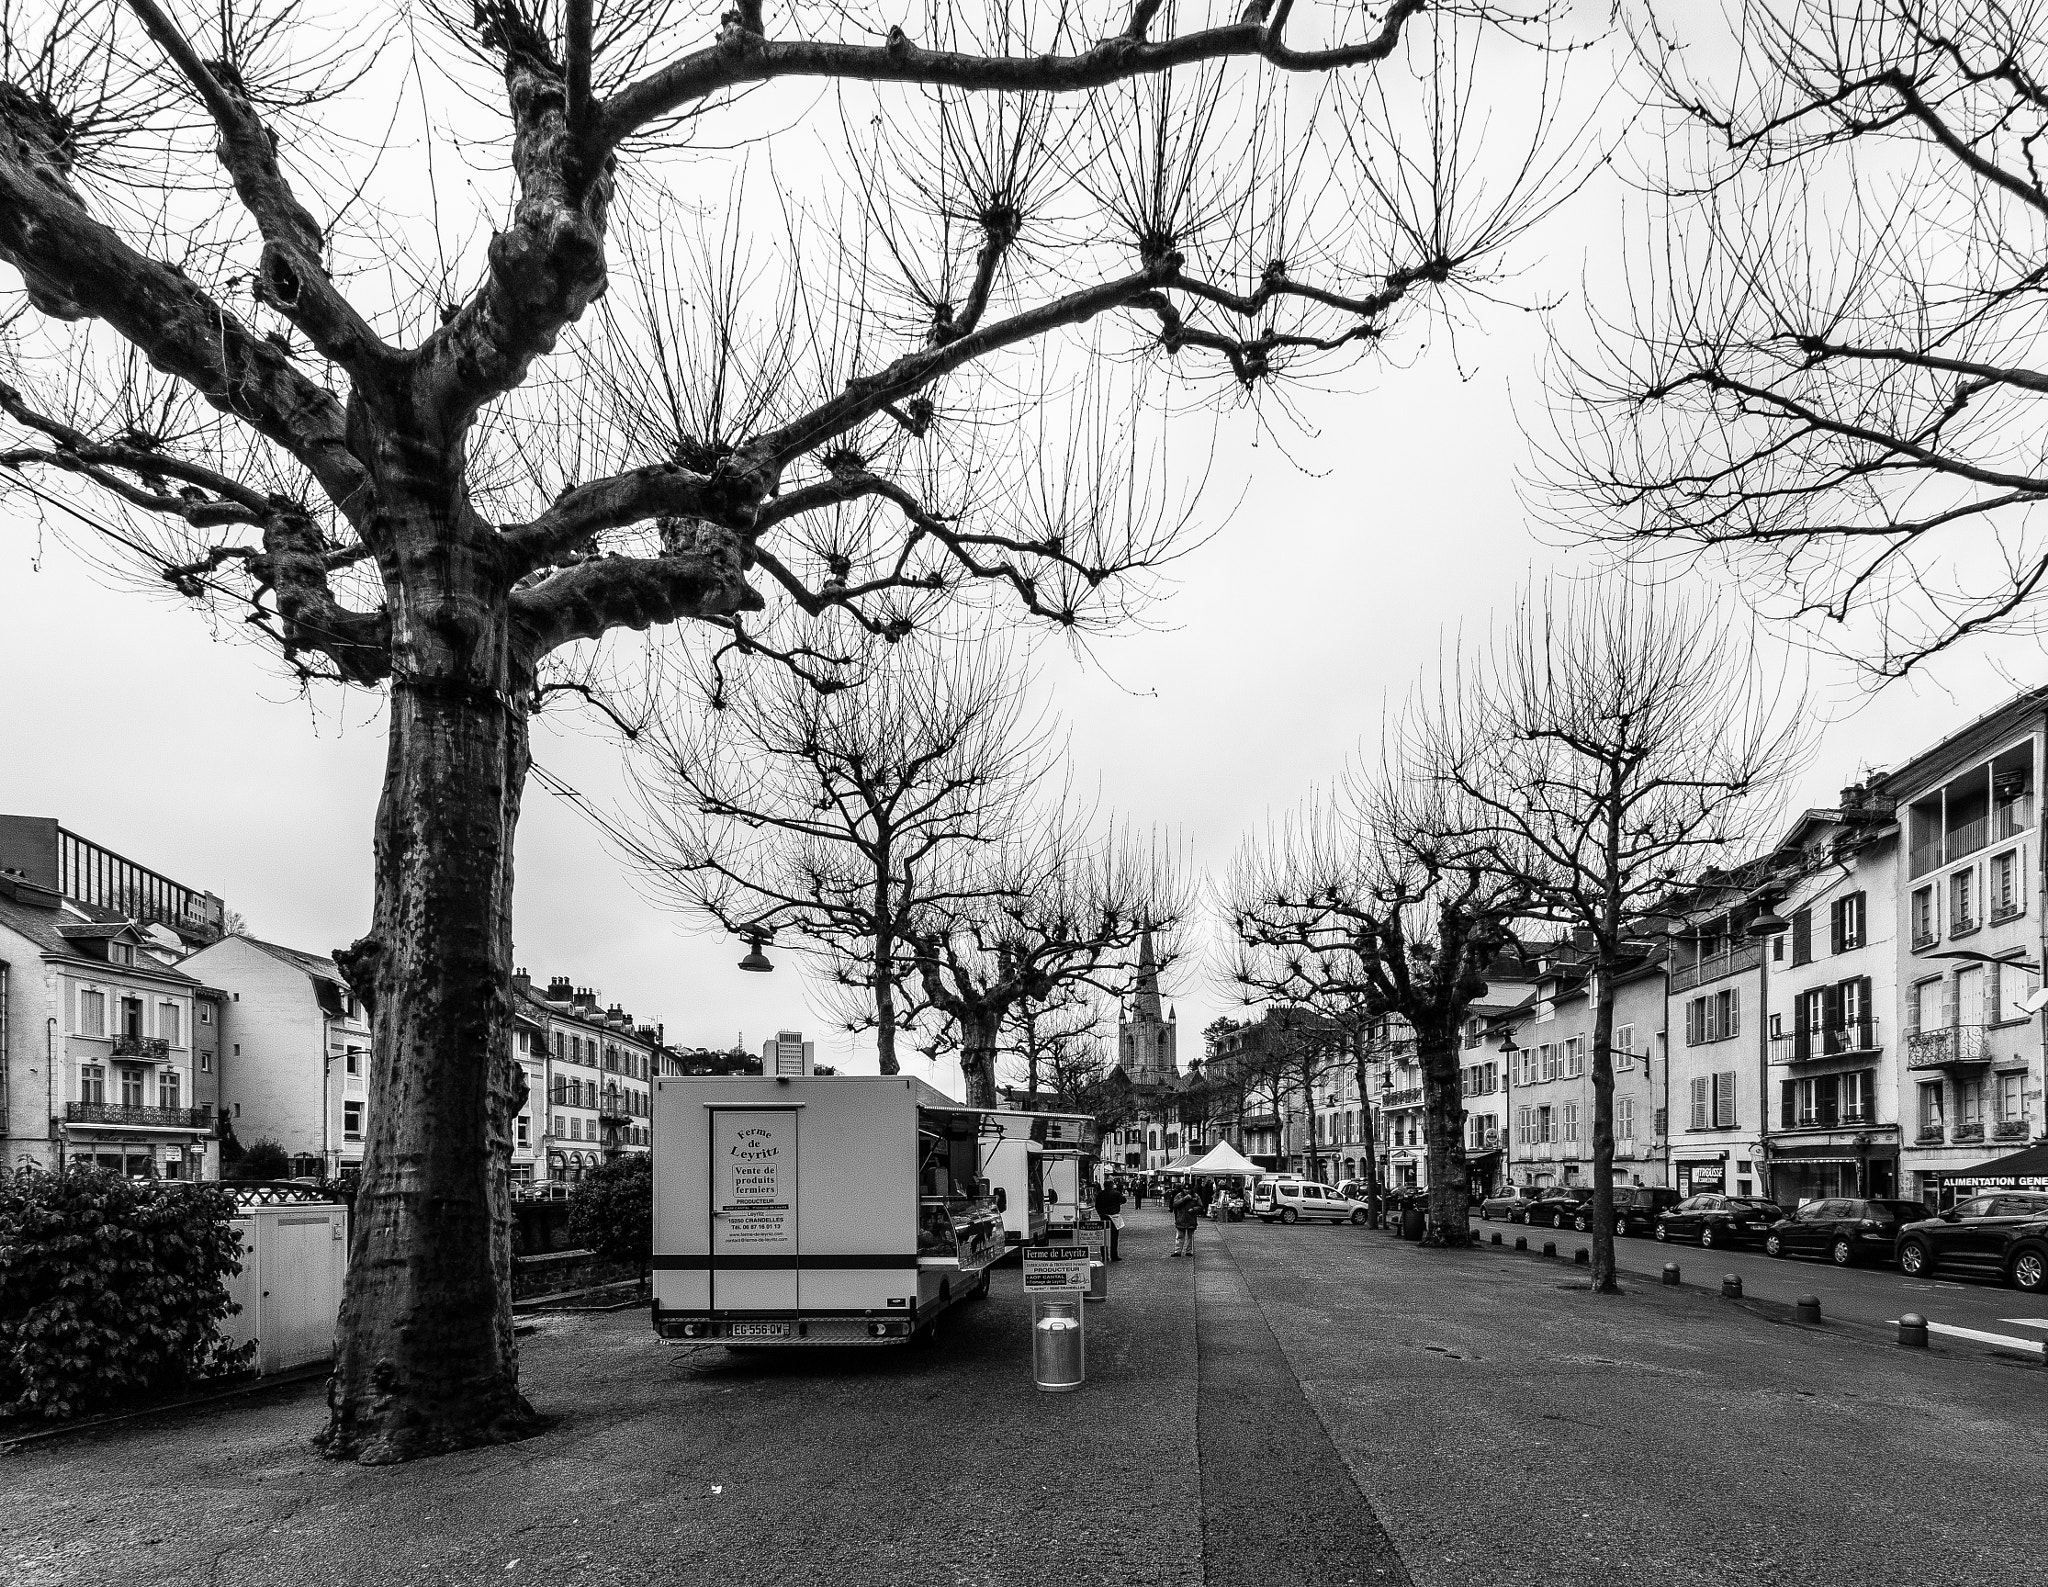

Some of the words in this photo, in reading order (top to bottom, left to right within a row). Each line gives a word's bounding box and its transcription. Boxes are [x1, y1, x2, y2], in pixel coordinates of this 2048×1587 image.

[737, 1128, 772, 1140] Ferme
[748, 1140, 760, 1148] de
[730, 1146, 780, 1162] Leyritz
[735, 1166, 761, 1174] Vente
[763, 1166, 775, 1174] de
[735, 1176, 775, 1186] produits
[1943, 1177, 2015, 1186] ALIMENTATION
[1026, 1249, 1048, 1258] Ferme
[1050, 1248, 1059, 1258] de
[1061, 1247, 1087, 1259] Leyritz
